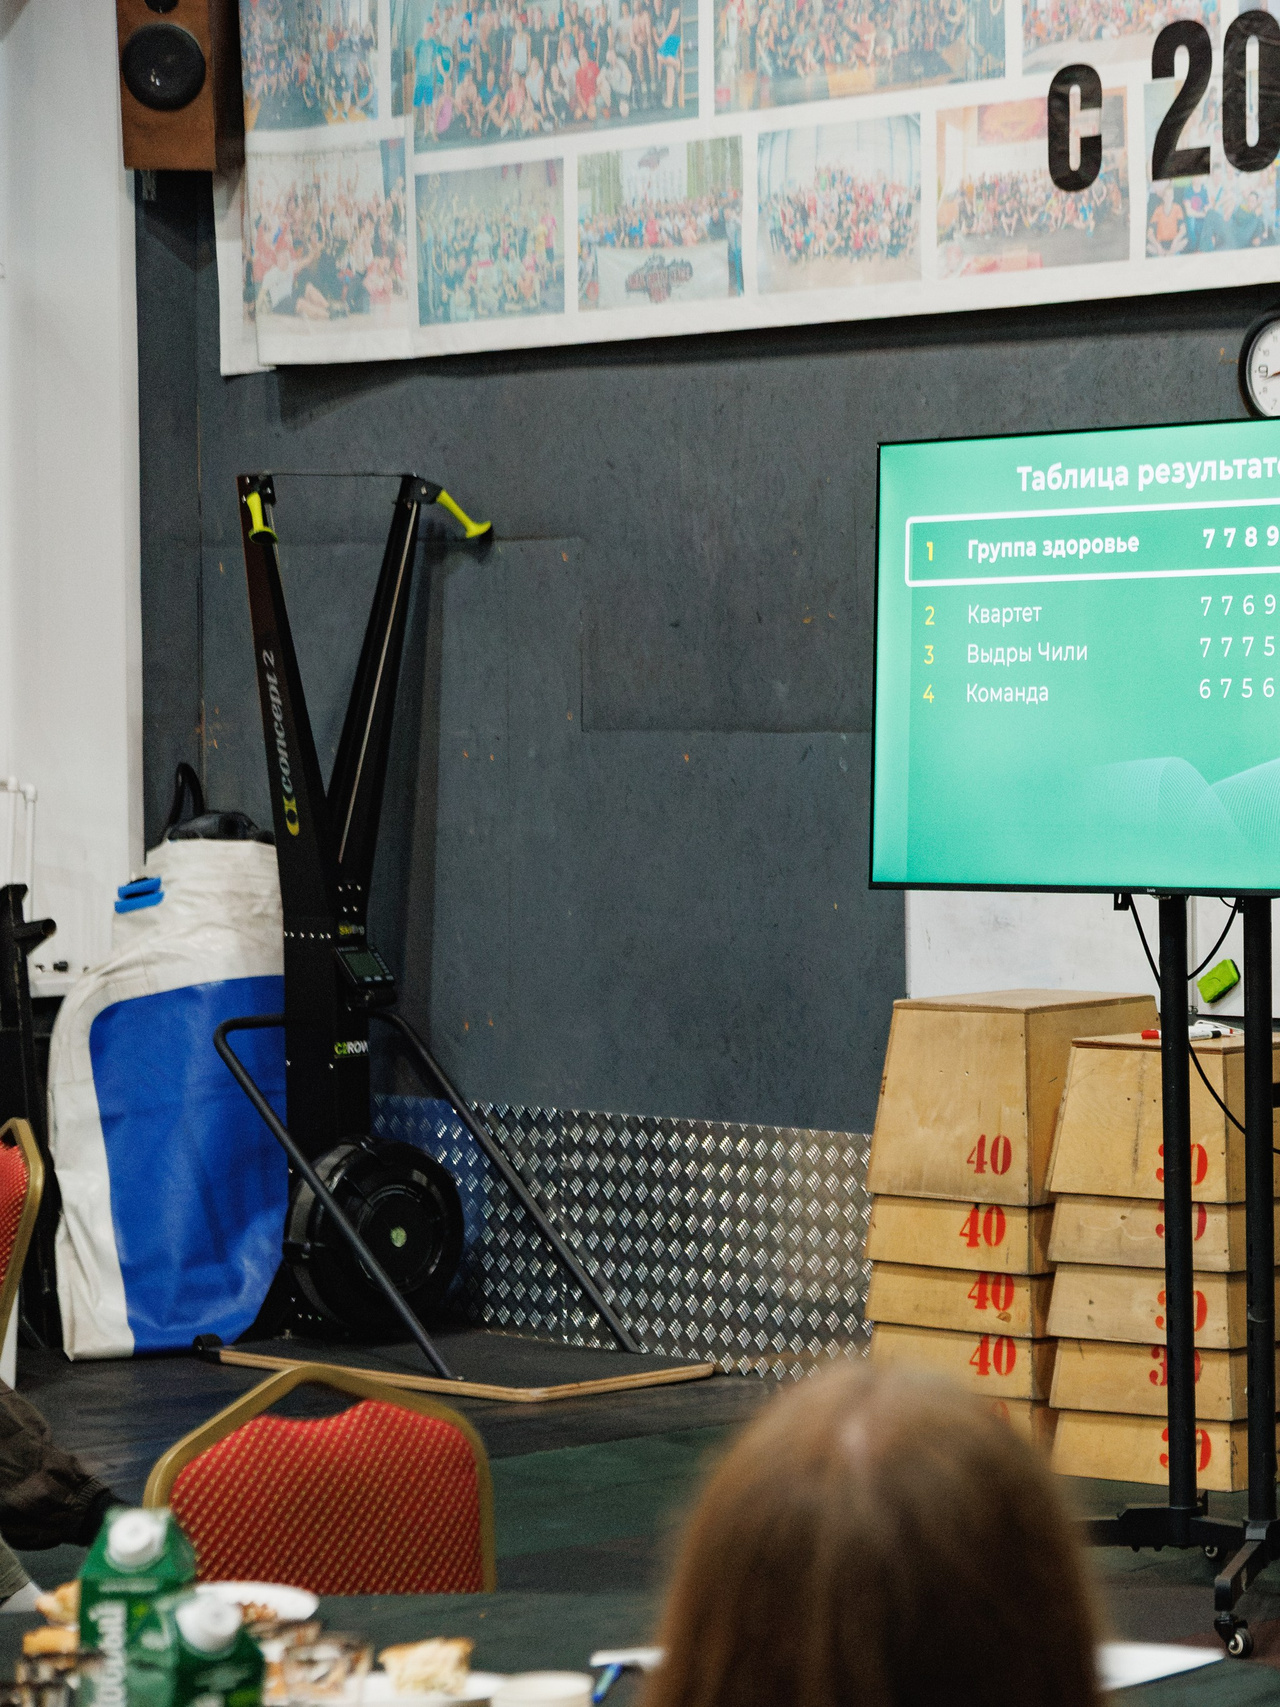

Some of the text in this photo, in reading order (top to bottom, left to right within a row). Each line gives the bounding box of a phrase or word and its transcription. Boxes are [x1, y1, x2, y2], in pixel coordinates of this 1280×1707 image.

[1258, 364, 1269, 378] 9
[1016, 462, 1129, 492] Таблица
[926, 541, 934, 561] 1
[968, 539, 1037, 564] Группа
[1042, 535, 1140, 560] здоровье
[1203, 528, 1216, 549] 7
[1223, 527, 1236, 548] 7
[1245, 526, 1258, 547] 8
[1266, 525, 1279, 546] 9
[925, 605, 935, 626] 2
[968, 604, 1043, 628] Квартет
[1200, 596, 1213, 617] 7
[1221, 595, 1233, 616] 7
[1242, 594, 1255, 616] 6
[1264, 593, 1276, 615] 9
[923, 644, 934, 665] 3
[967, 643, 1032, 667] Выдры
[1037, 642, 1088, 662] Чили
[1199, 637, 1212, 658] 7
[1221, 636, 1233, 658] 7
[1242, 636, 1254, 657] 7
[1263, 635, 1275, 657] 5
[922, 684, 935, 703] 4
[966, 683, 1049, 705] Команда
[1199, 678, 1211, 699] 6
[1220, 678, 1232, 699] 7
[1241, 677, 1253, 699] 5
[1262, 677, 1275, 698] 6
[262, 649, 293, 794] concept 2
[966, 1133, 1013, 1176] 40
[959, 1205, 1007, 1248] 40
[967, 1271, 1015, 1312] 40
[968, 1334, 1017, 1377] 40
[1149, 1344, 1202, 1387] 3
